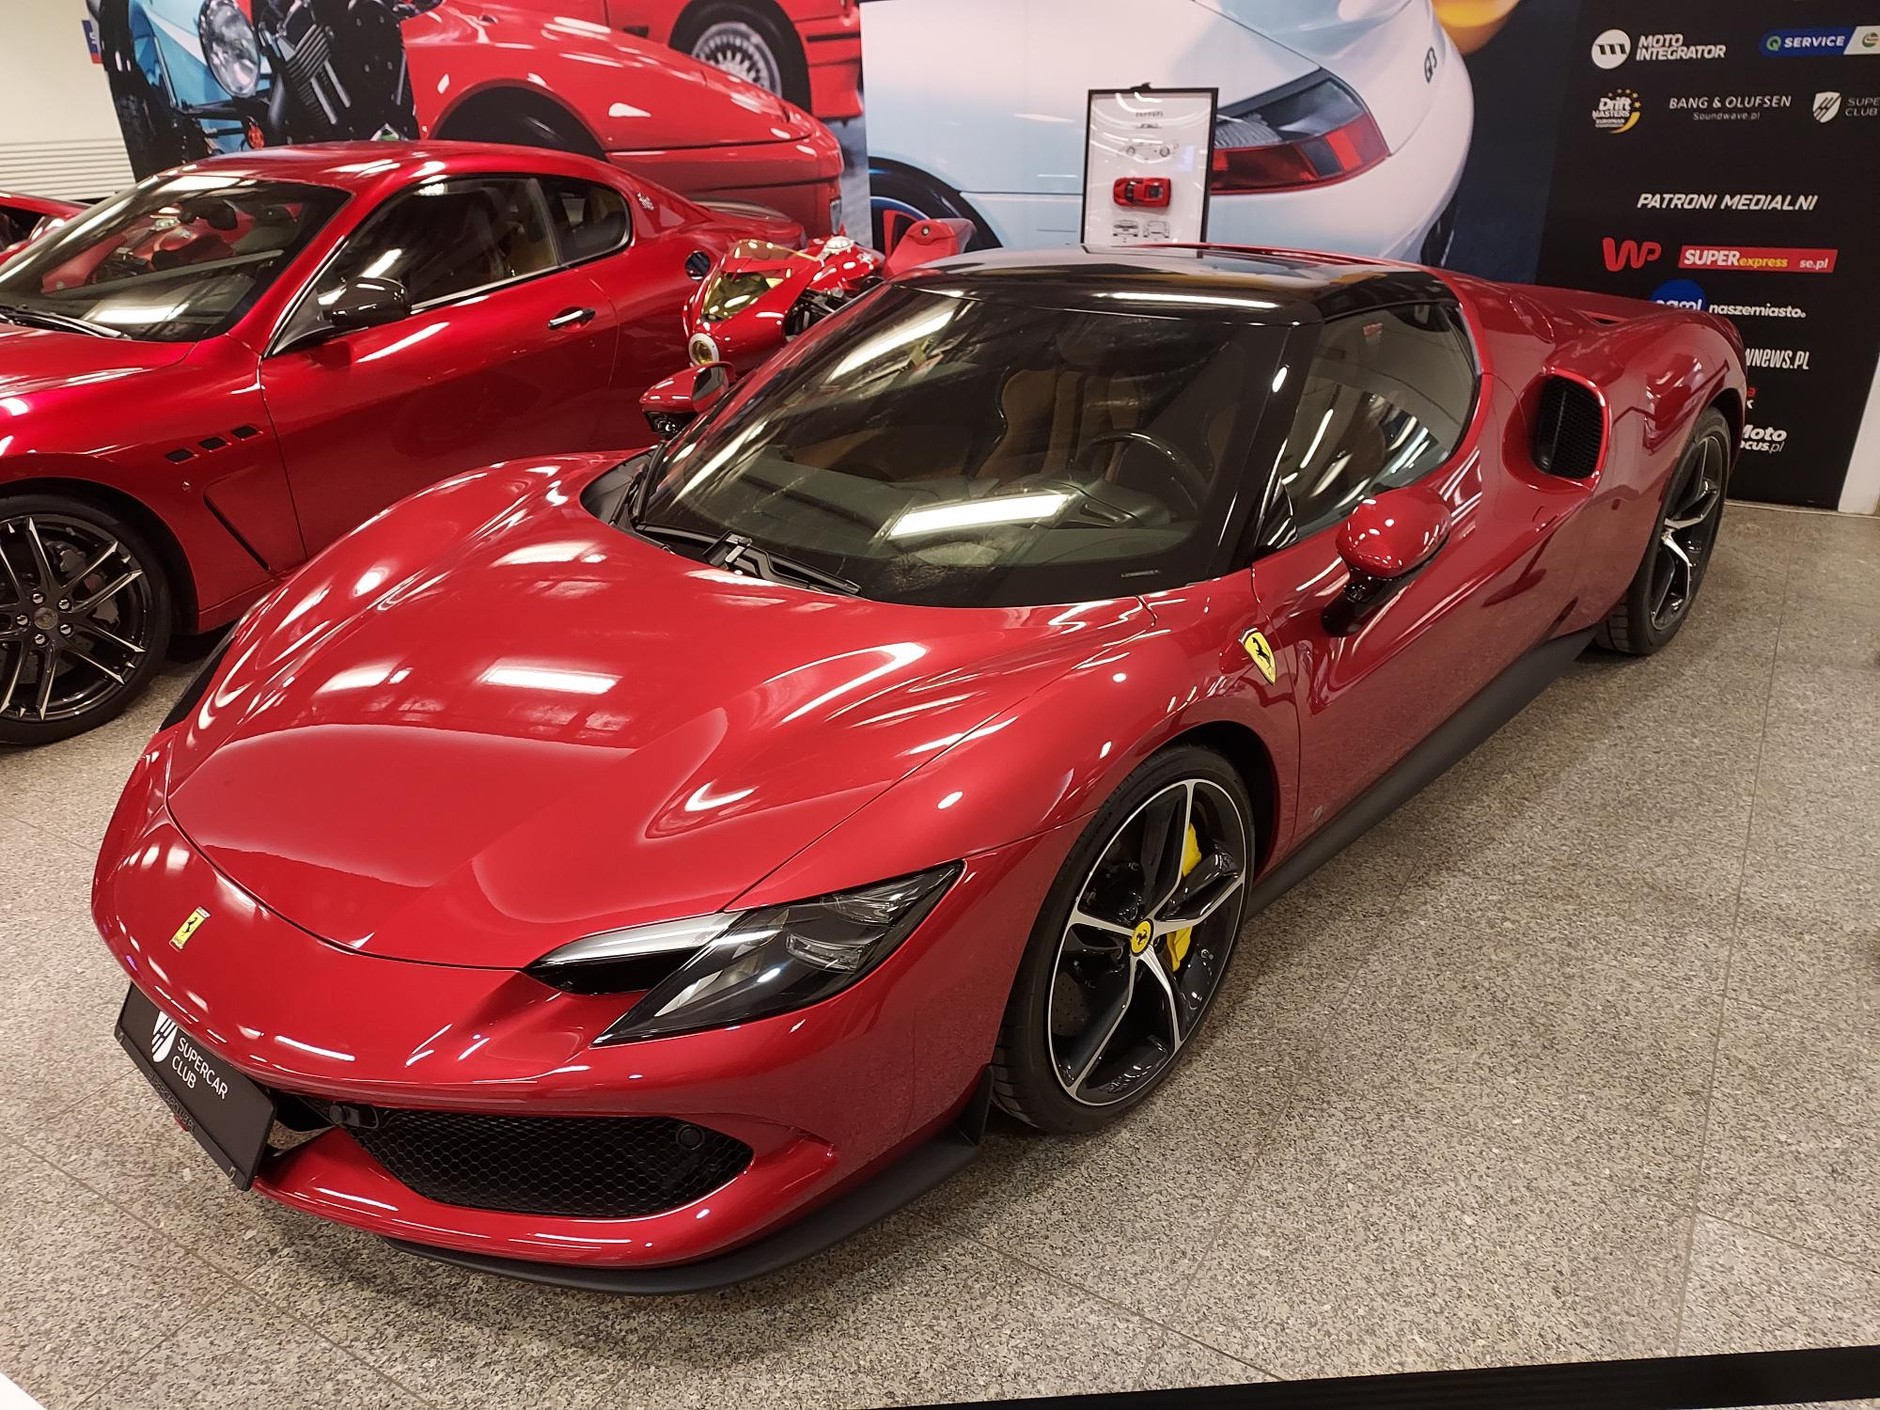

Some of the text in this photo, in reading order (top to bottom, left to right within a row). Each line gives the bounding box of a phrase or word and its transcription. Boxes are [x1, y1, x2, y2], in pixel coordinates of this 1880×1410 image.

[1638, 33, 1684, 47] MOTO
[1784, 36, 1846, 48] SERVICE
[1636, 45, 1726, 61] INTEGRATOR
[1669, 95, 1792, 109] BANG & OLUFSEN
[1845, 107, 1878, 117] CLUB
[1637, 193, 1818, 211] PATRONI MEDIALNI
[1602, 237, 1662, 272] WP
[1799, 258, 1829, 270] se.pl
[171, 1055, 198, 1090] CLUB
[177, 1037, 229, 1100] SUPERCAR
